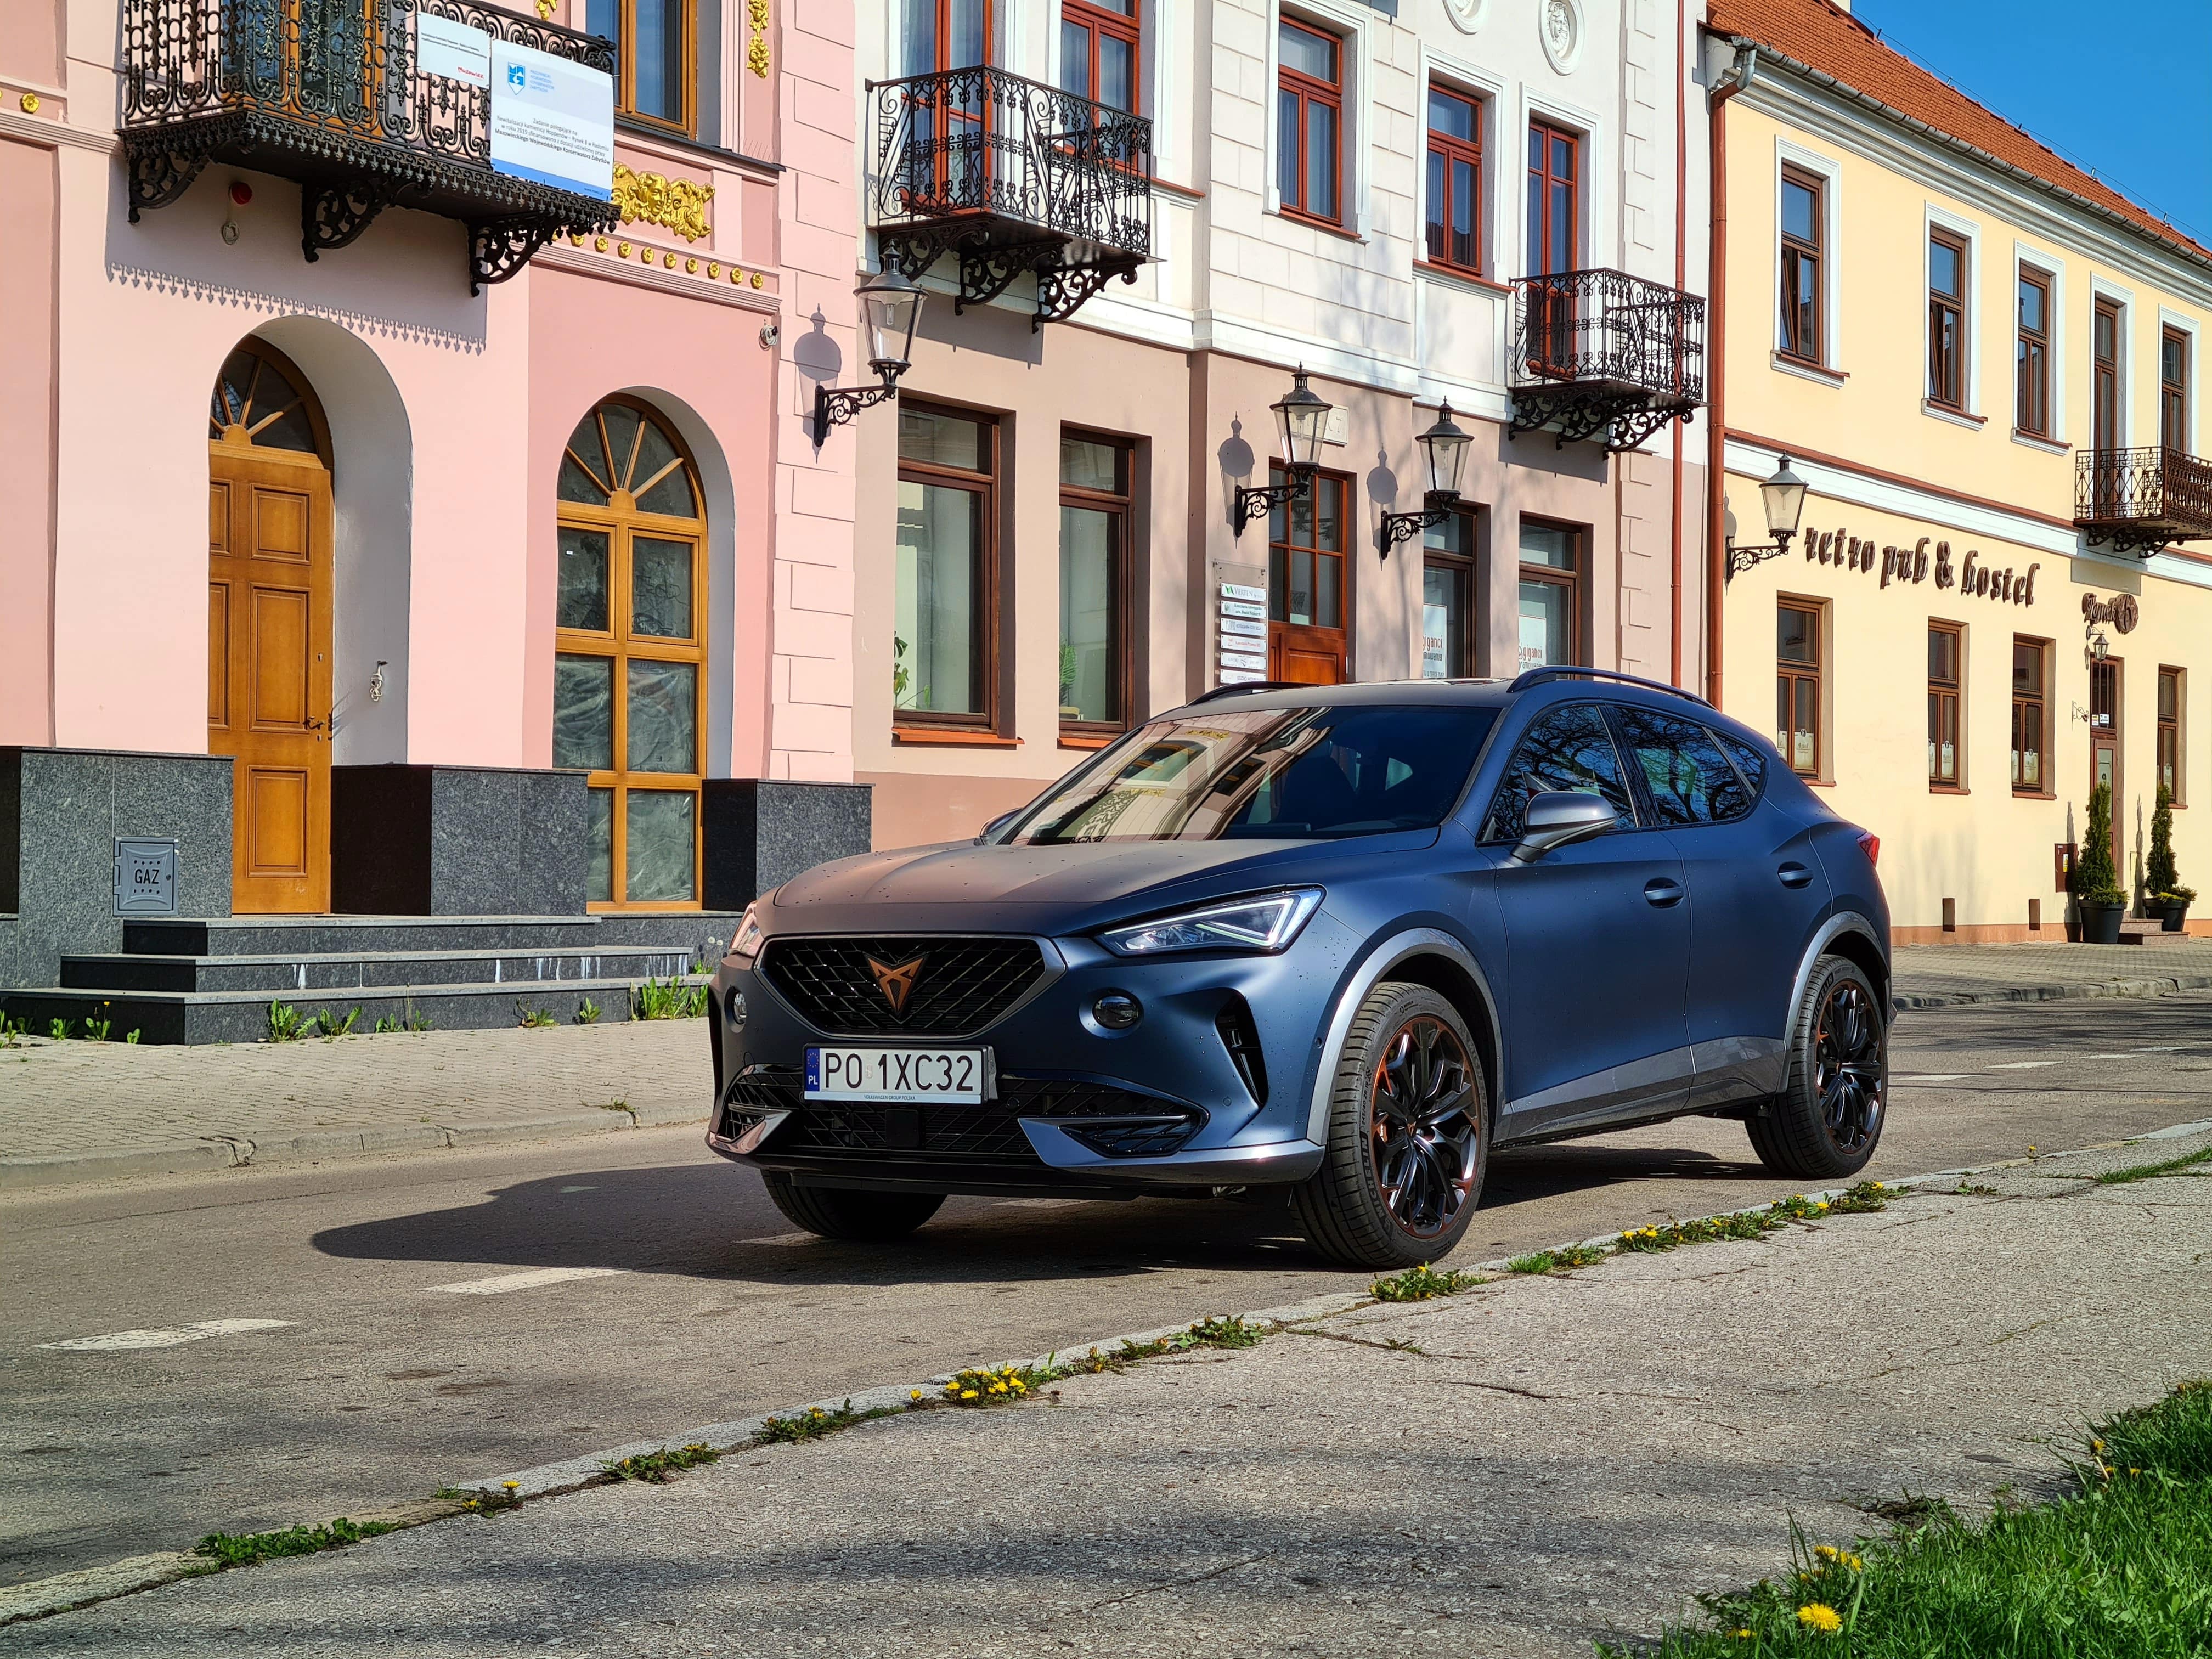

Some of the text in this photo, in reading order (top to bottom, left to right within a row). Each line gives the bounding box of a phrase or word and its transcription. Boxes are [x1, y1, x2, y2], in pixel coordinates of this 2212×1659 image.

[1805, 527, 2041, 608] retro pub & hostel
[1523, 645, 1542, 662] giganci
[134, 868, 160, 884] GAZ
[808, 1075, 818, 1085] PL
[825, 1052, 973, 1091] PO 1XC32
[1359, 1137, 1386, 1219] MICHELIN
